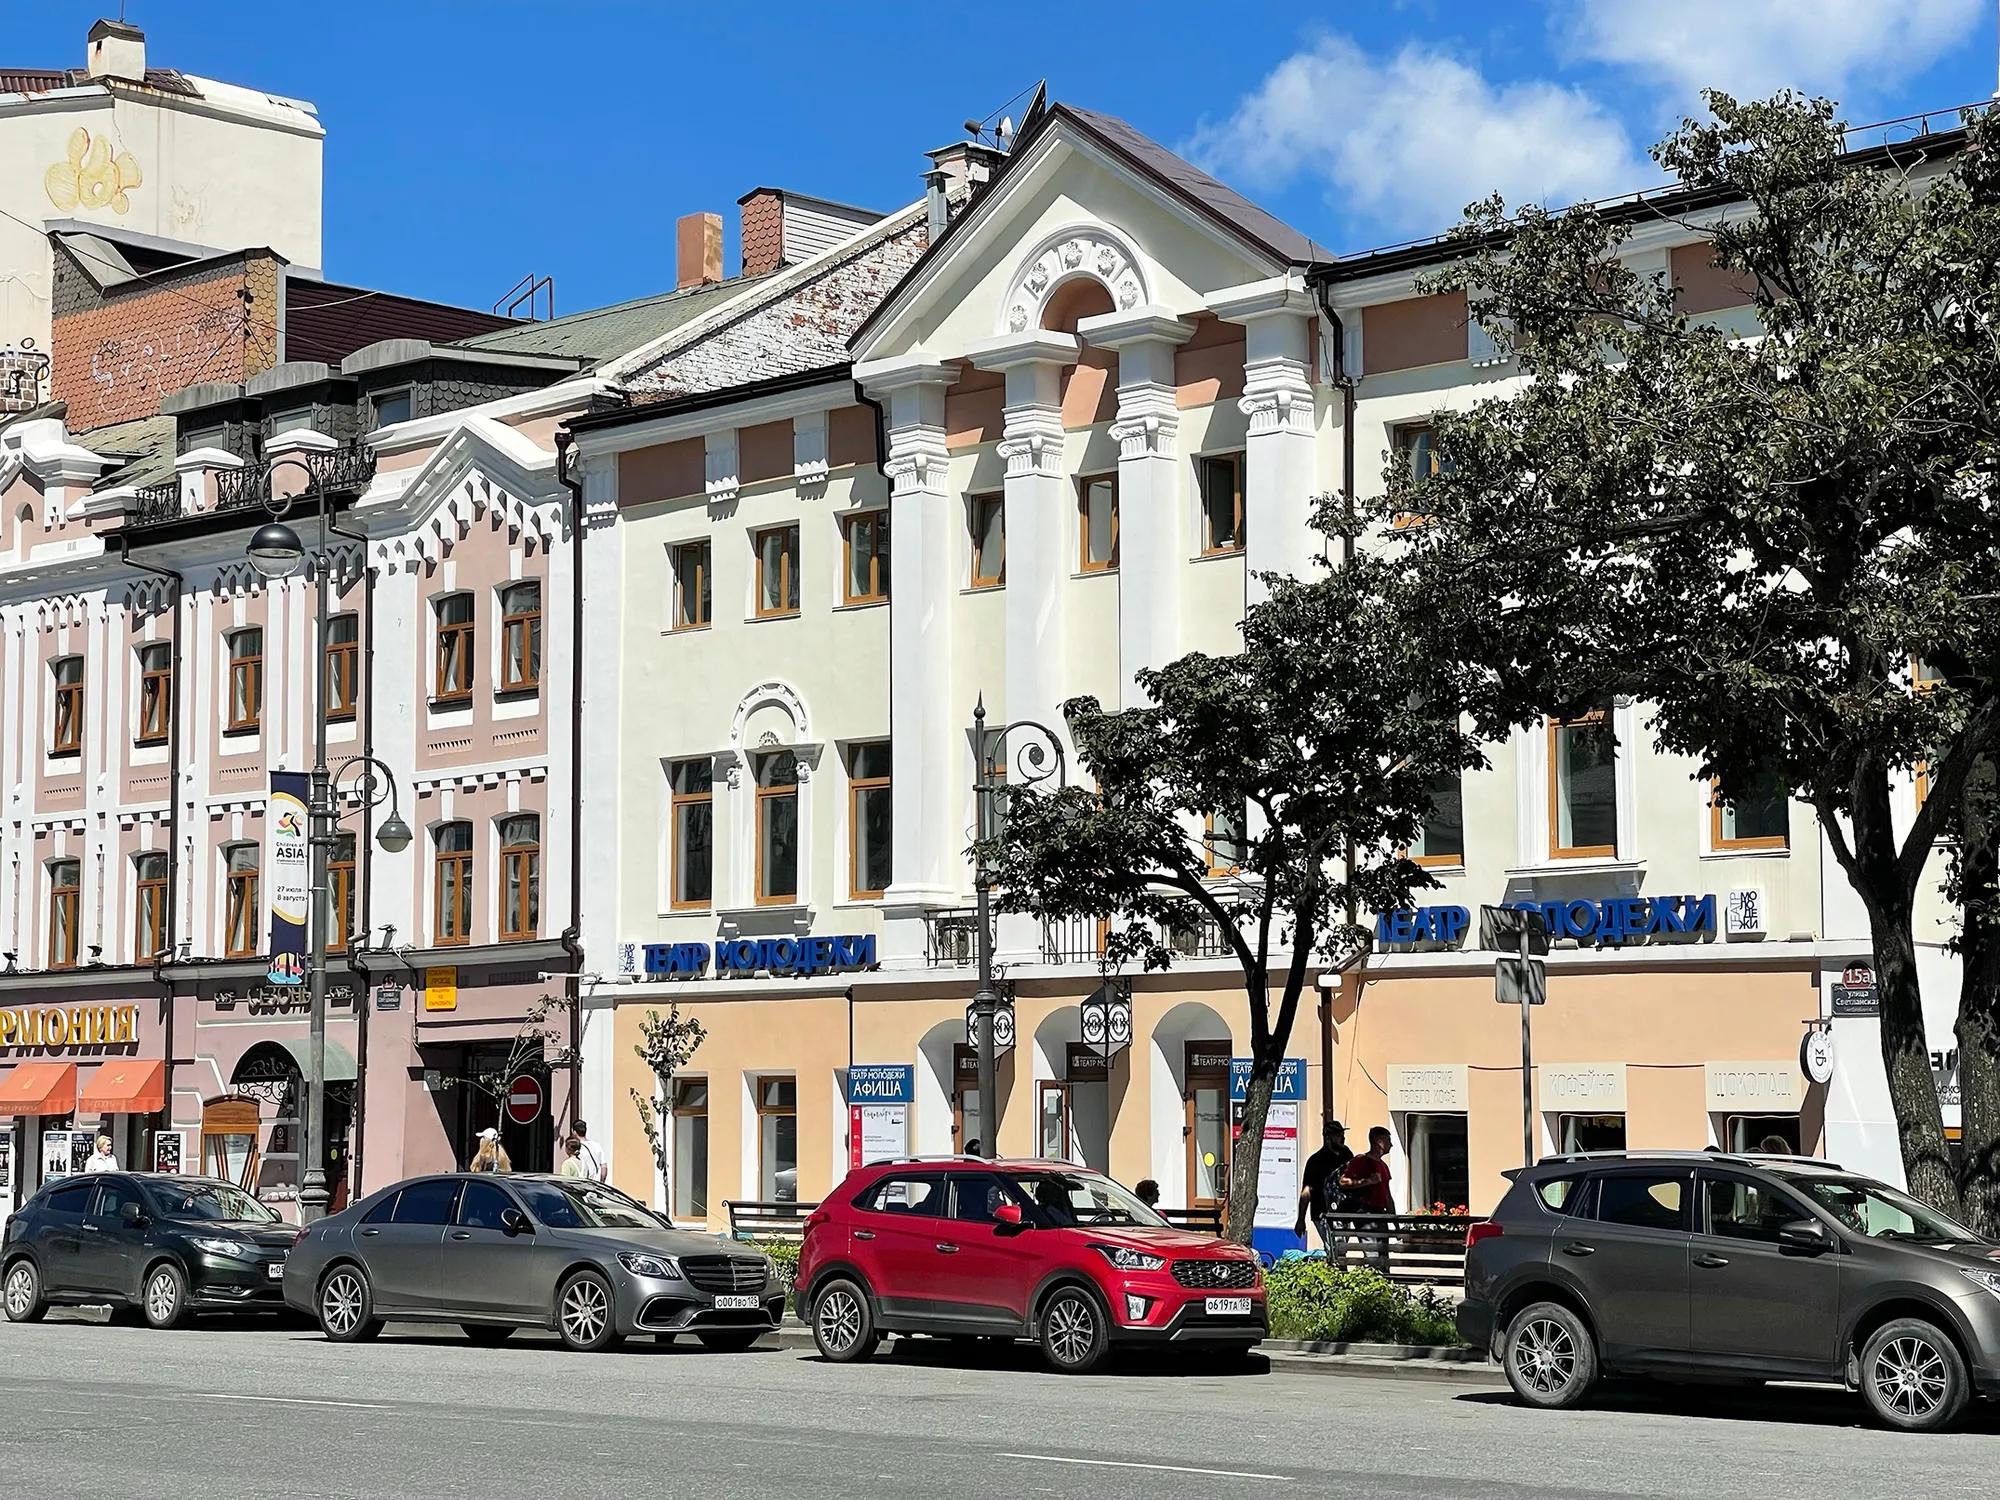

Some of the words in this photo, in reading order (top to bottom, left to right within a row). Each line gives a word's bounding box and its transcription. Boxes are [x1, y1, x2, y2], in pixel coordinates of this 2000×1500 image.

[276, 847, 305, 859] ASIA
[1377, 904, 1470, 944] ТЕАТР
[1500, 894, 1717, 944] ЛОДЕЖИ
[642, 942, 711, 974] ТЕАТР
[715, 934, 877, 974] МОЛОДЕЖИ
[1846, 969, 1870, 984] 15а
[850, 1072, 868, 1080] ТЕАТР
[868, 1071, 905, 1080] МОЛОДЕЖИ
[1232, 1065, 1253, 1074] ТЕАТР
[853, 1081, 903, 1096] АФИША
